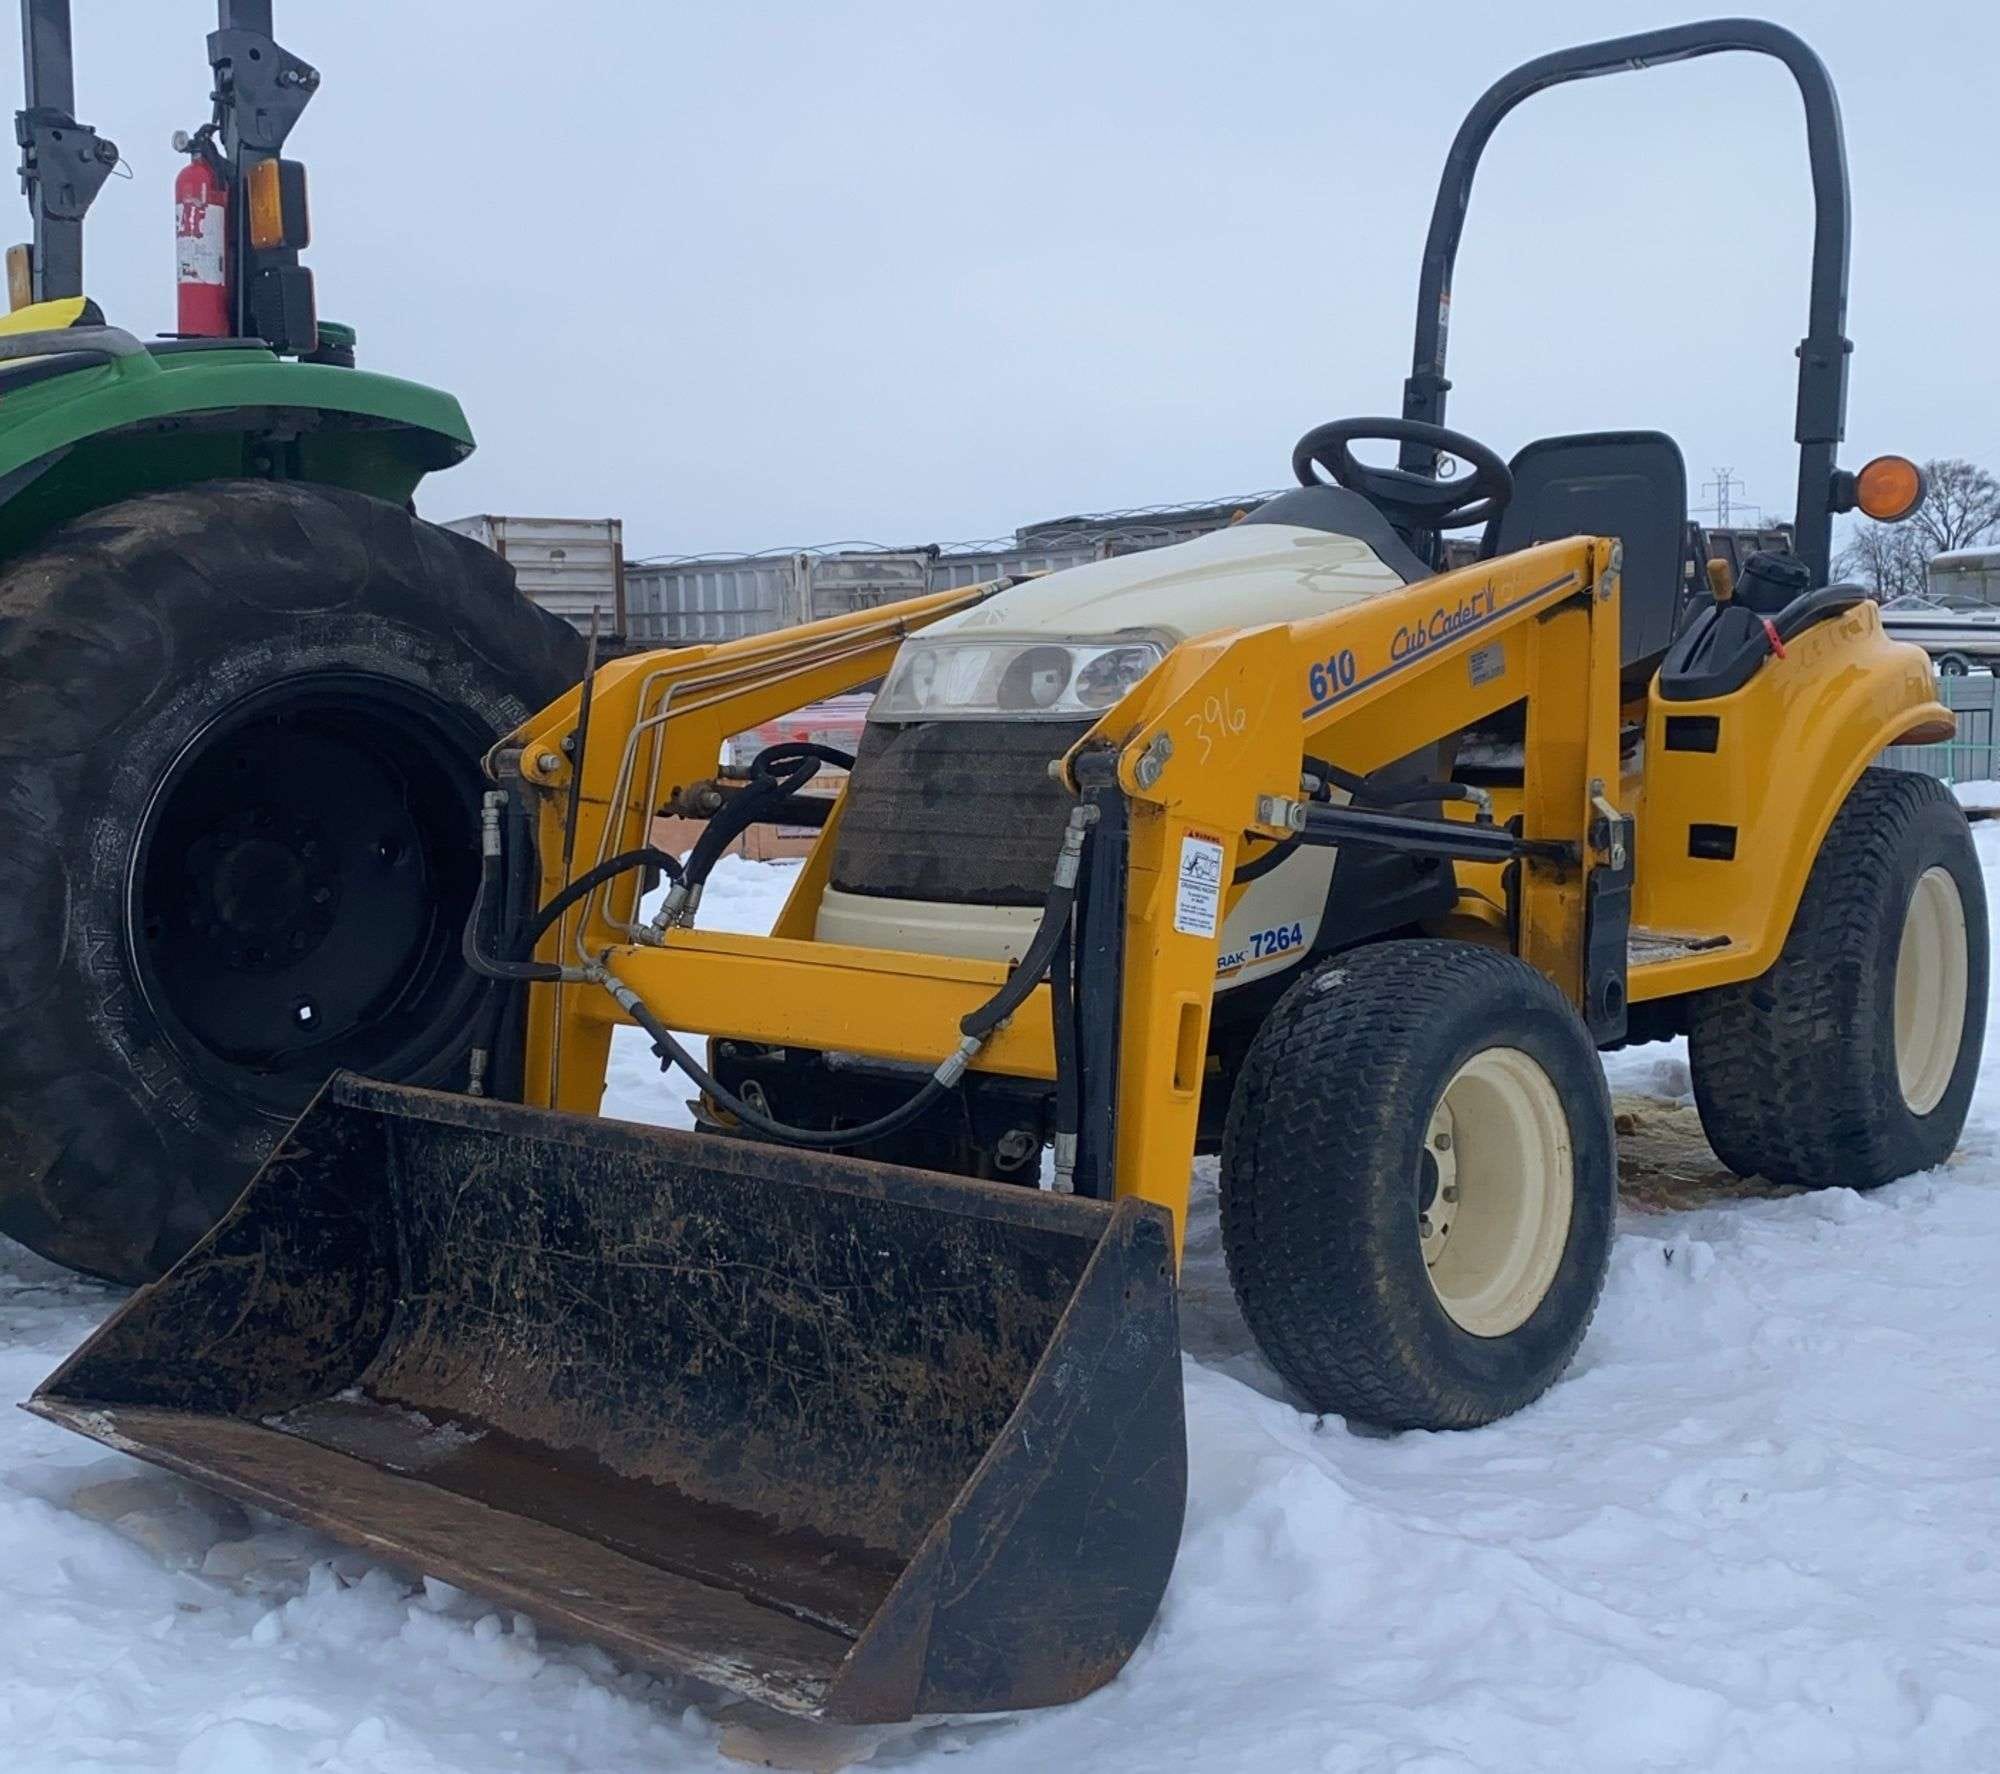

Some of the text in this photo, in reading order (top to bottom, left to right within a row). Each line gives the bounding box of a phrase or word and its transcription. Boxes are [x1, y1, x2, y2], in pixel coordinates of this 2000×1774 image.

[1390, 591, 1484, 661] Cub Cadet
[1308, 649, 1356, 702] 610
[1184, 687, 1247, 766] 396
[1216, 922, 1303, 969] RAK 7264
